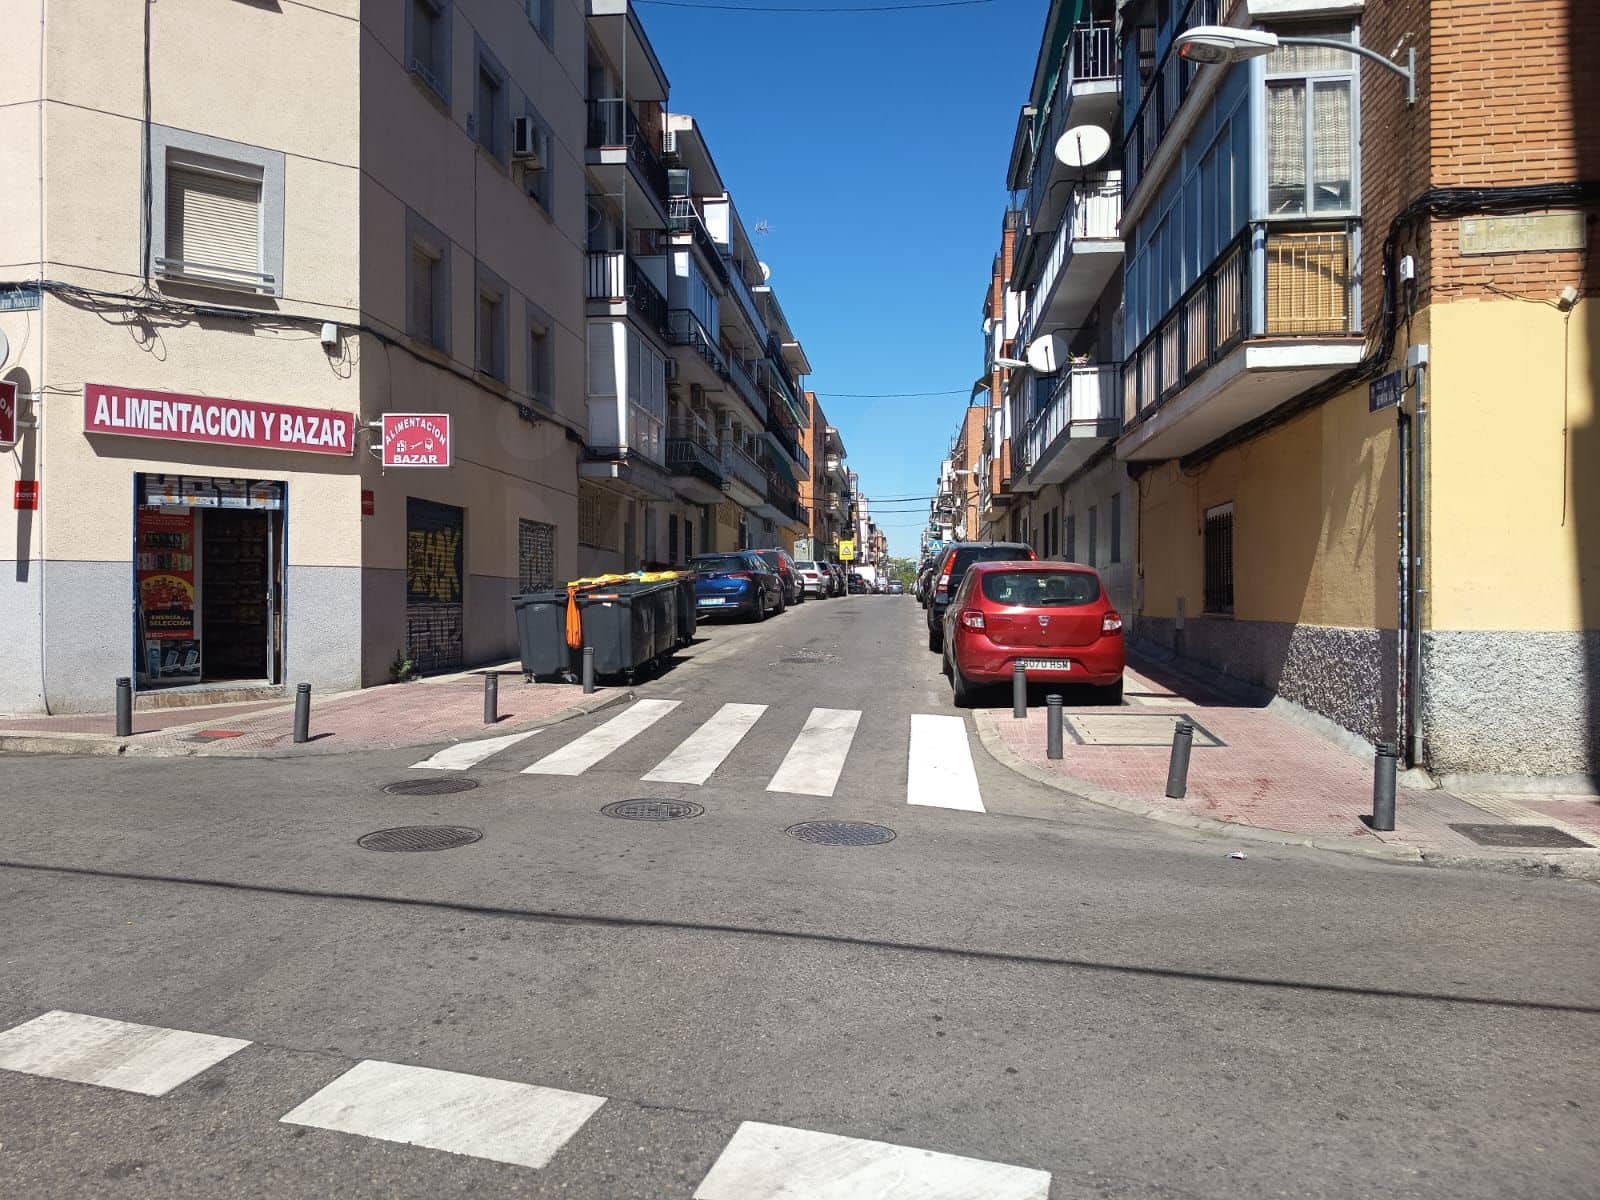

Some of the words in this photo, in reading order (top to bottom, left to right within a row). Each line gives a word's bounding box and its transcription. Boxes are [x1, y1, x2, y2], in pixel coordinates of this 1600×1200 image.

[93, 395, 255, 439] ALIMENTACION
[261, 411, 275, 440] Y
[279, 413, 346, 447] BAZAR
[385, 417, 446, 446] ALIMENTACION
[393, 455, 438, 463] BAZAR
